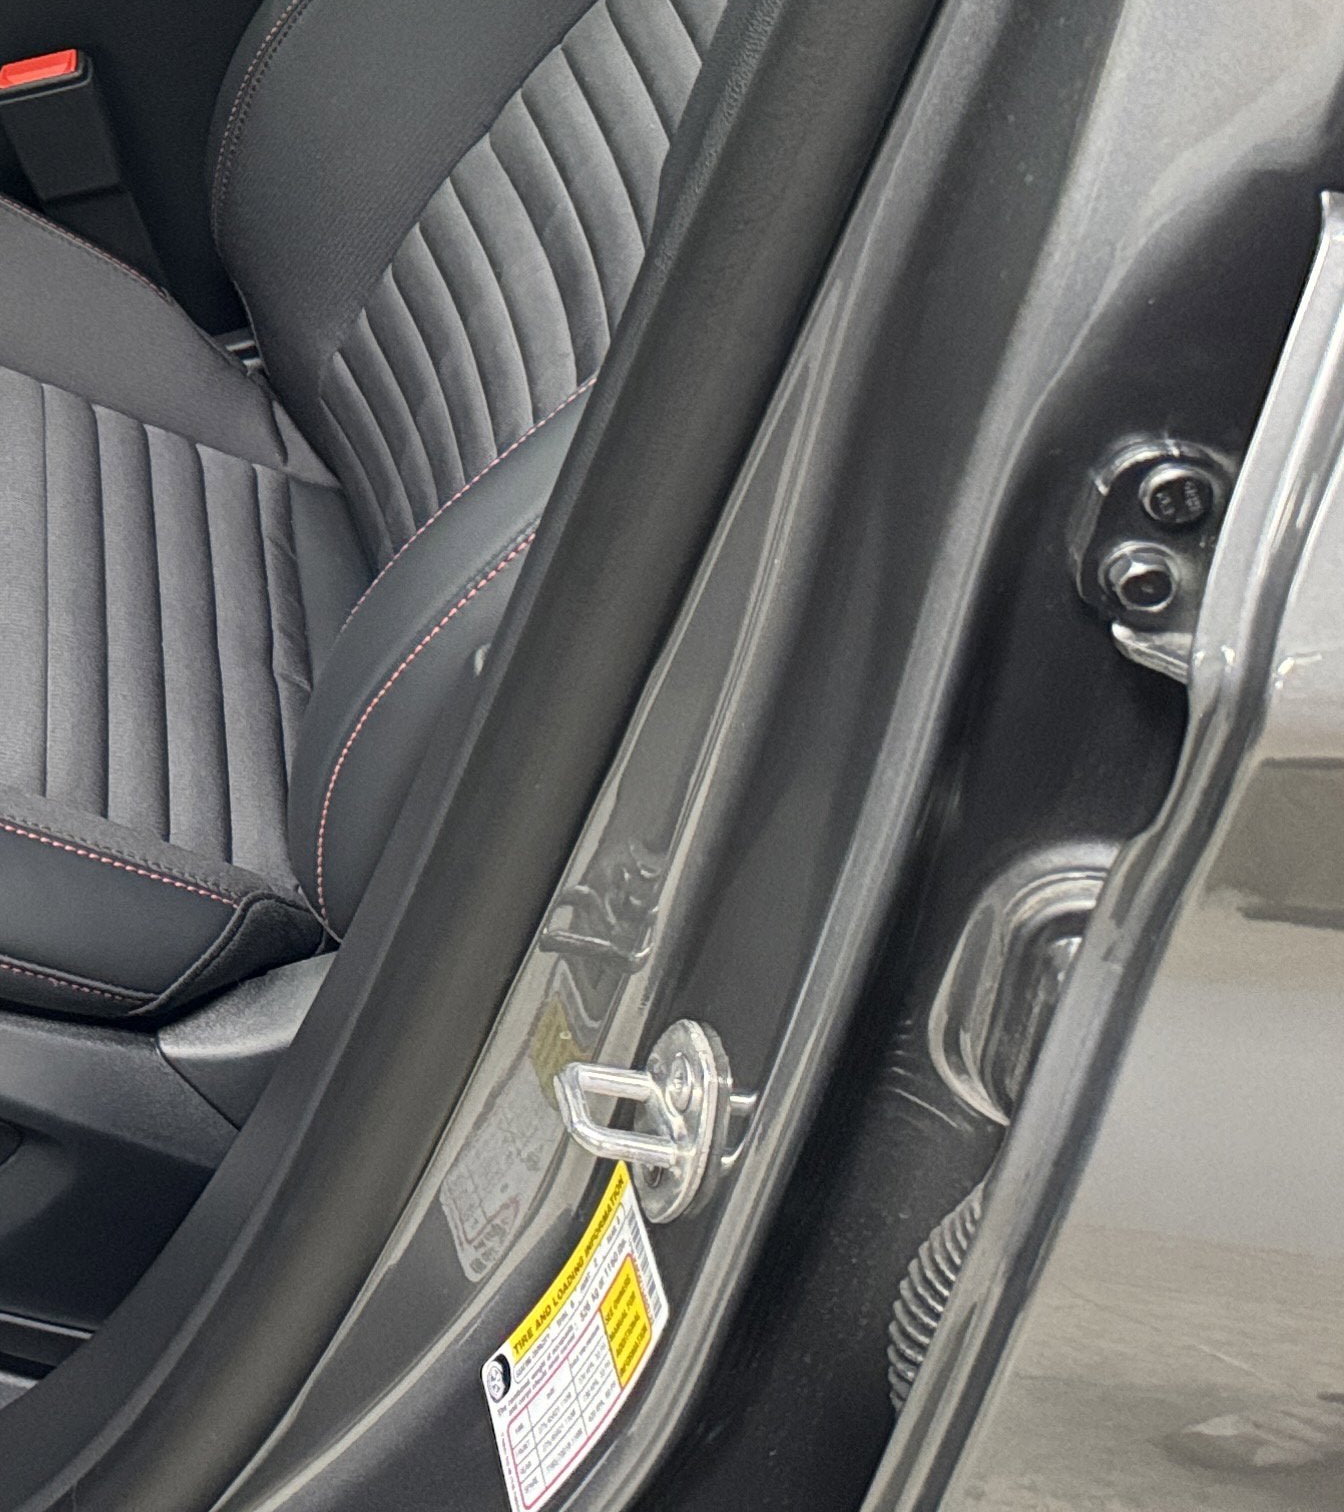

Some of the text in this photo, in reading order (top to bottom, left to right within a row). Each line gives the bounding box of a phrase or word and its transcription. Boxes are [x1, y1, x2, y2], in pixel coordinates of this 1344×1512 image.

[512, 1331, 534, 1355] TIRE
[535, 1307, 552, 1332] AND
[552, 1257, 586, 1307] LOADING
[584, 1174, 625, 1260] INFORMATION
